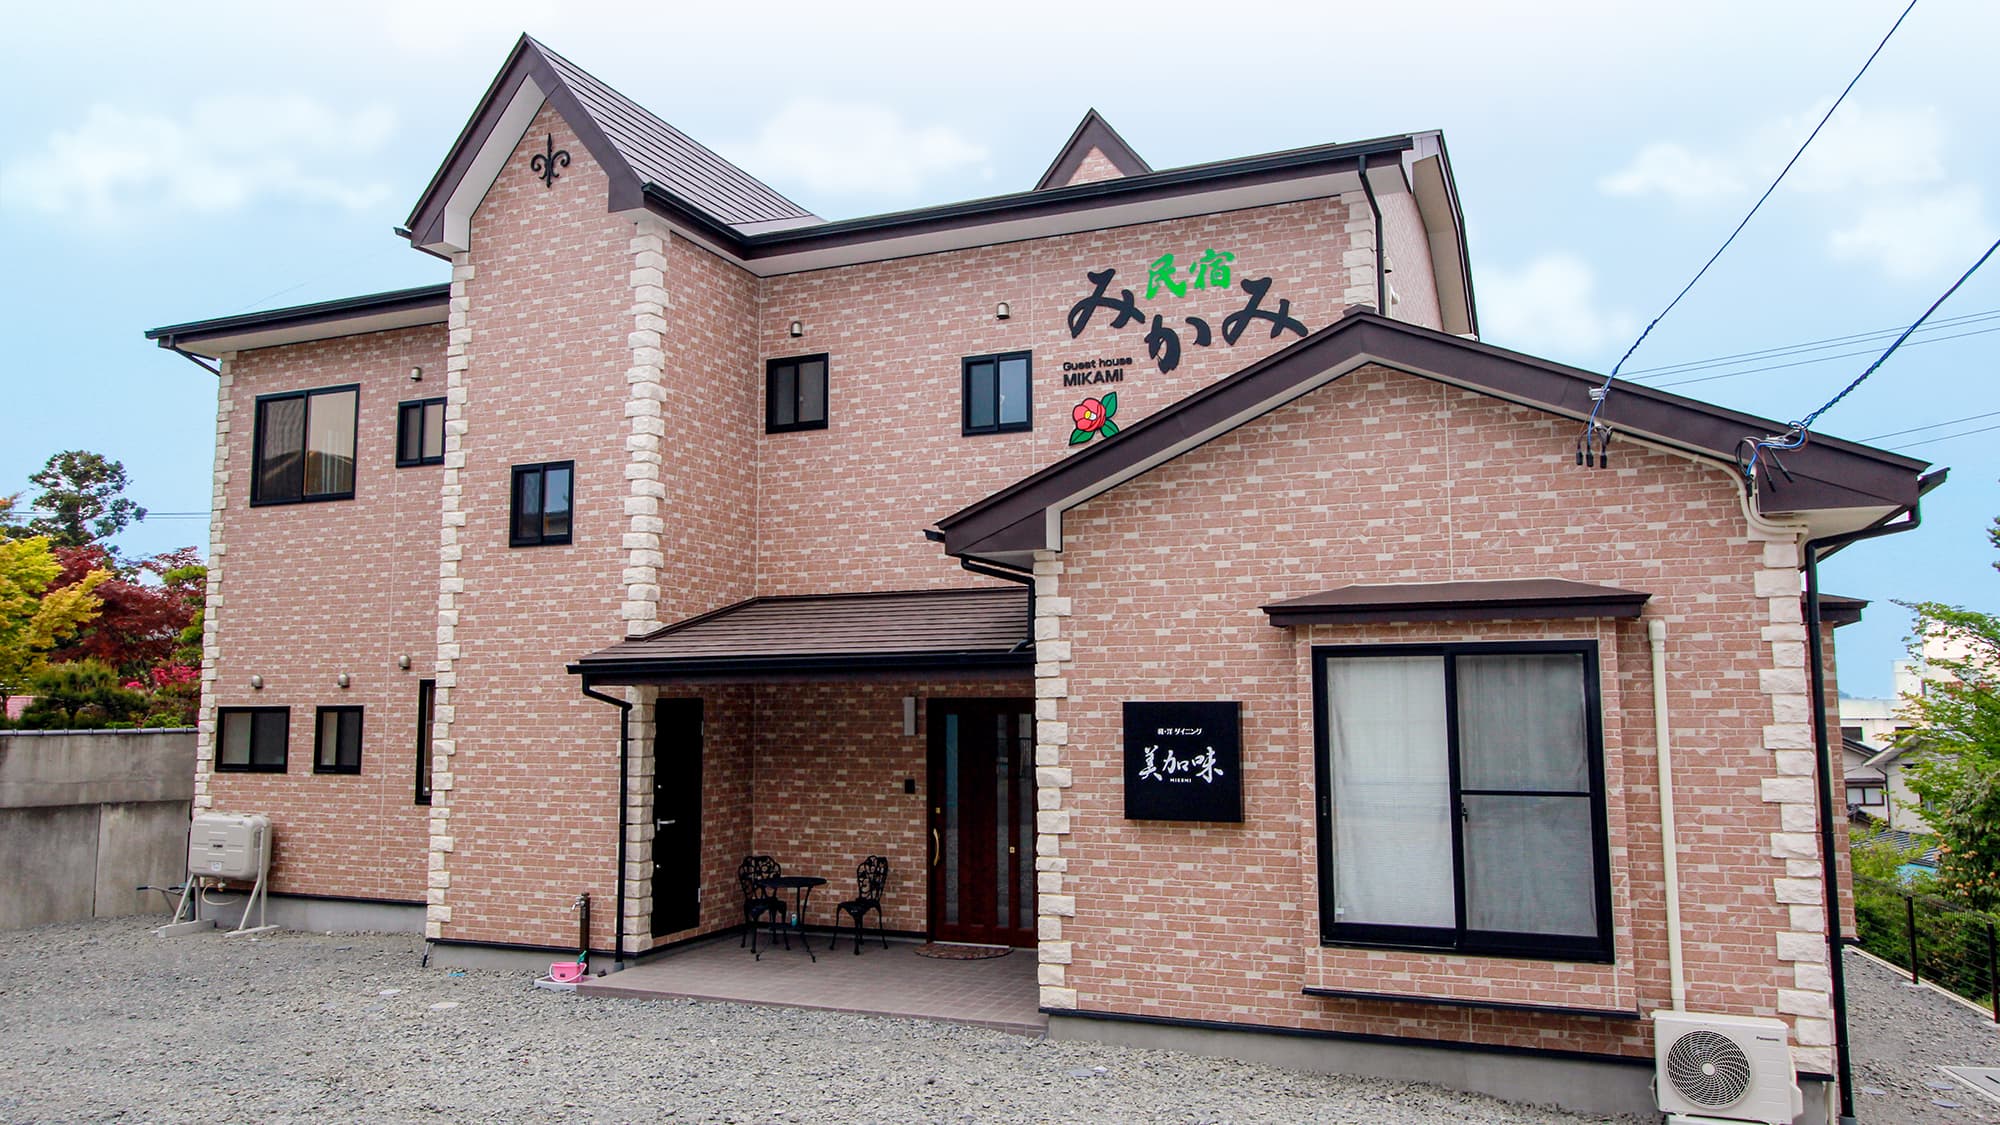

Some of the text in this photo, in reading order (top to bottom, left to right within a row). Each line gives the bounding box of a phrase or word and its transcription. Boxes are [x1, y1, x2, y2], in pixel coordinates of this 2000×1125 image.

[1146, 248, 1235, 300] 民宿
[1067, 268, 1309, 374] みかみ
[1063, 357, 1133, 371] Guest house
[1063, 368, 1123, 387] MIKAMI
[1138, 744, 1224, 784] 美加味
